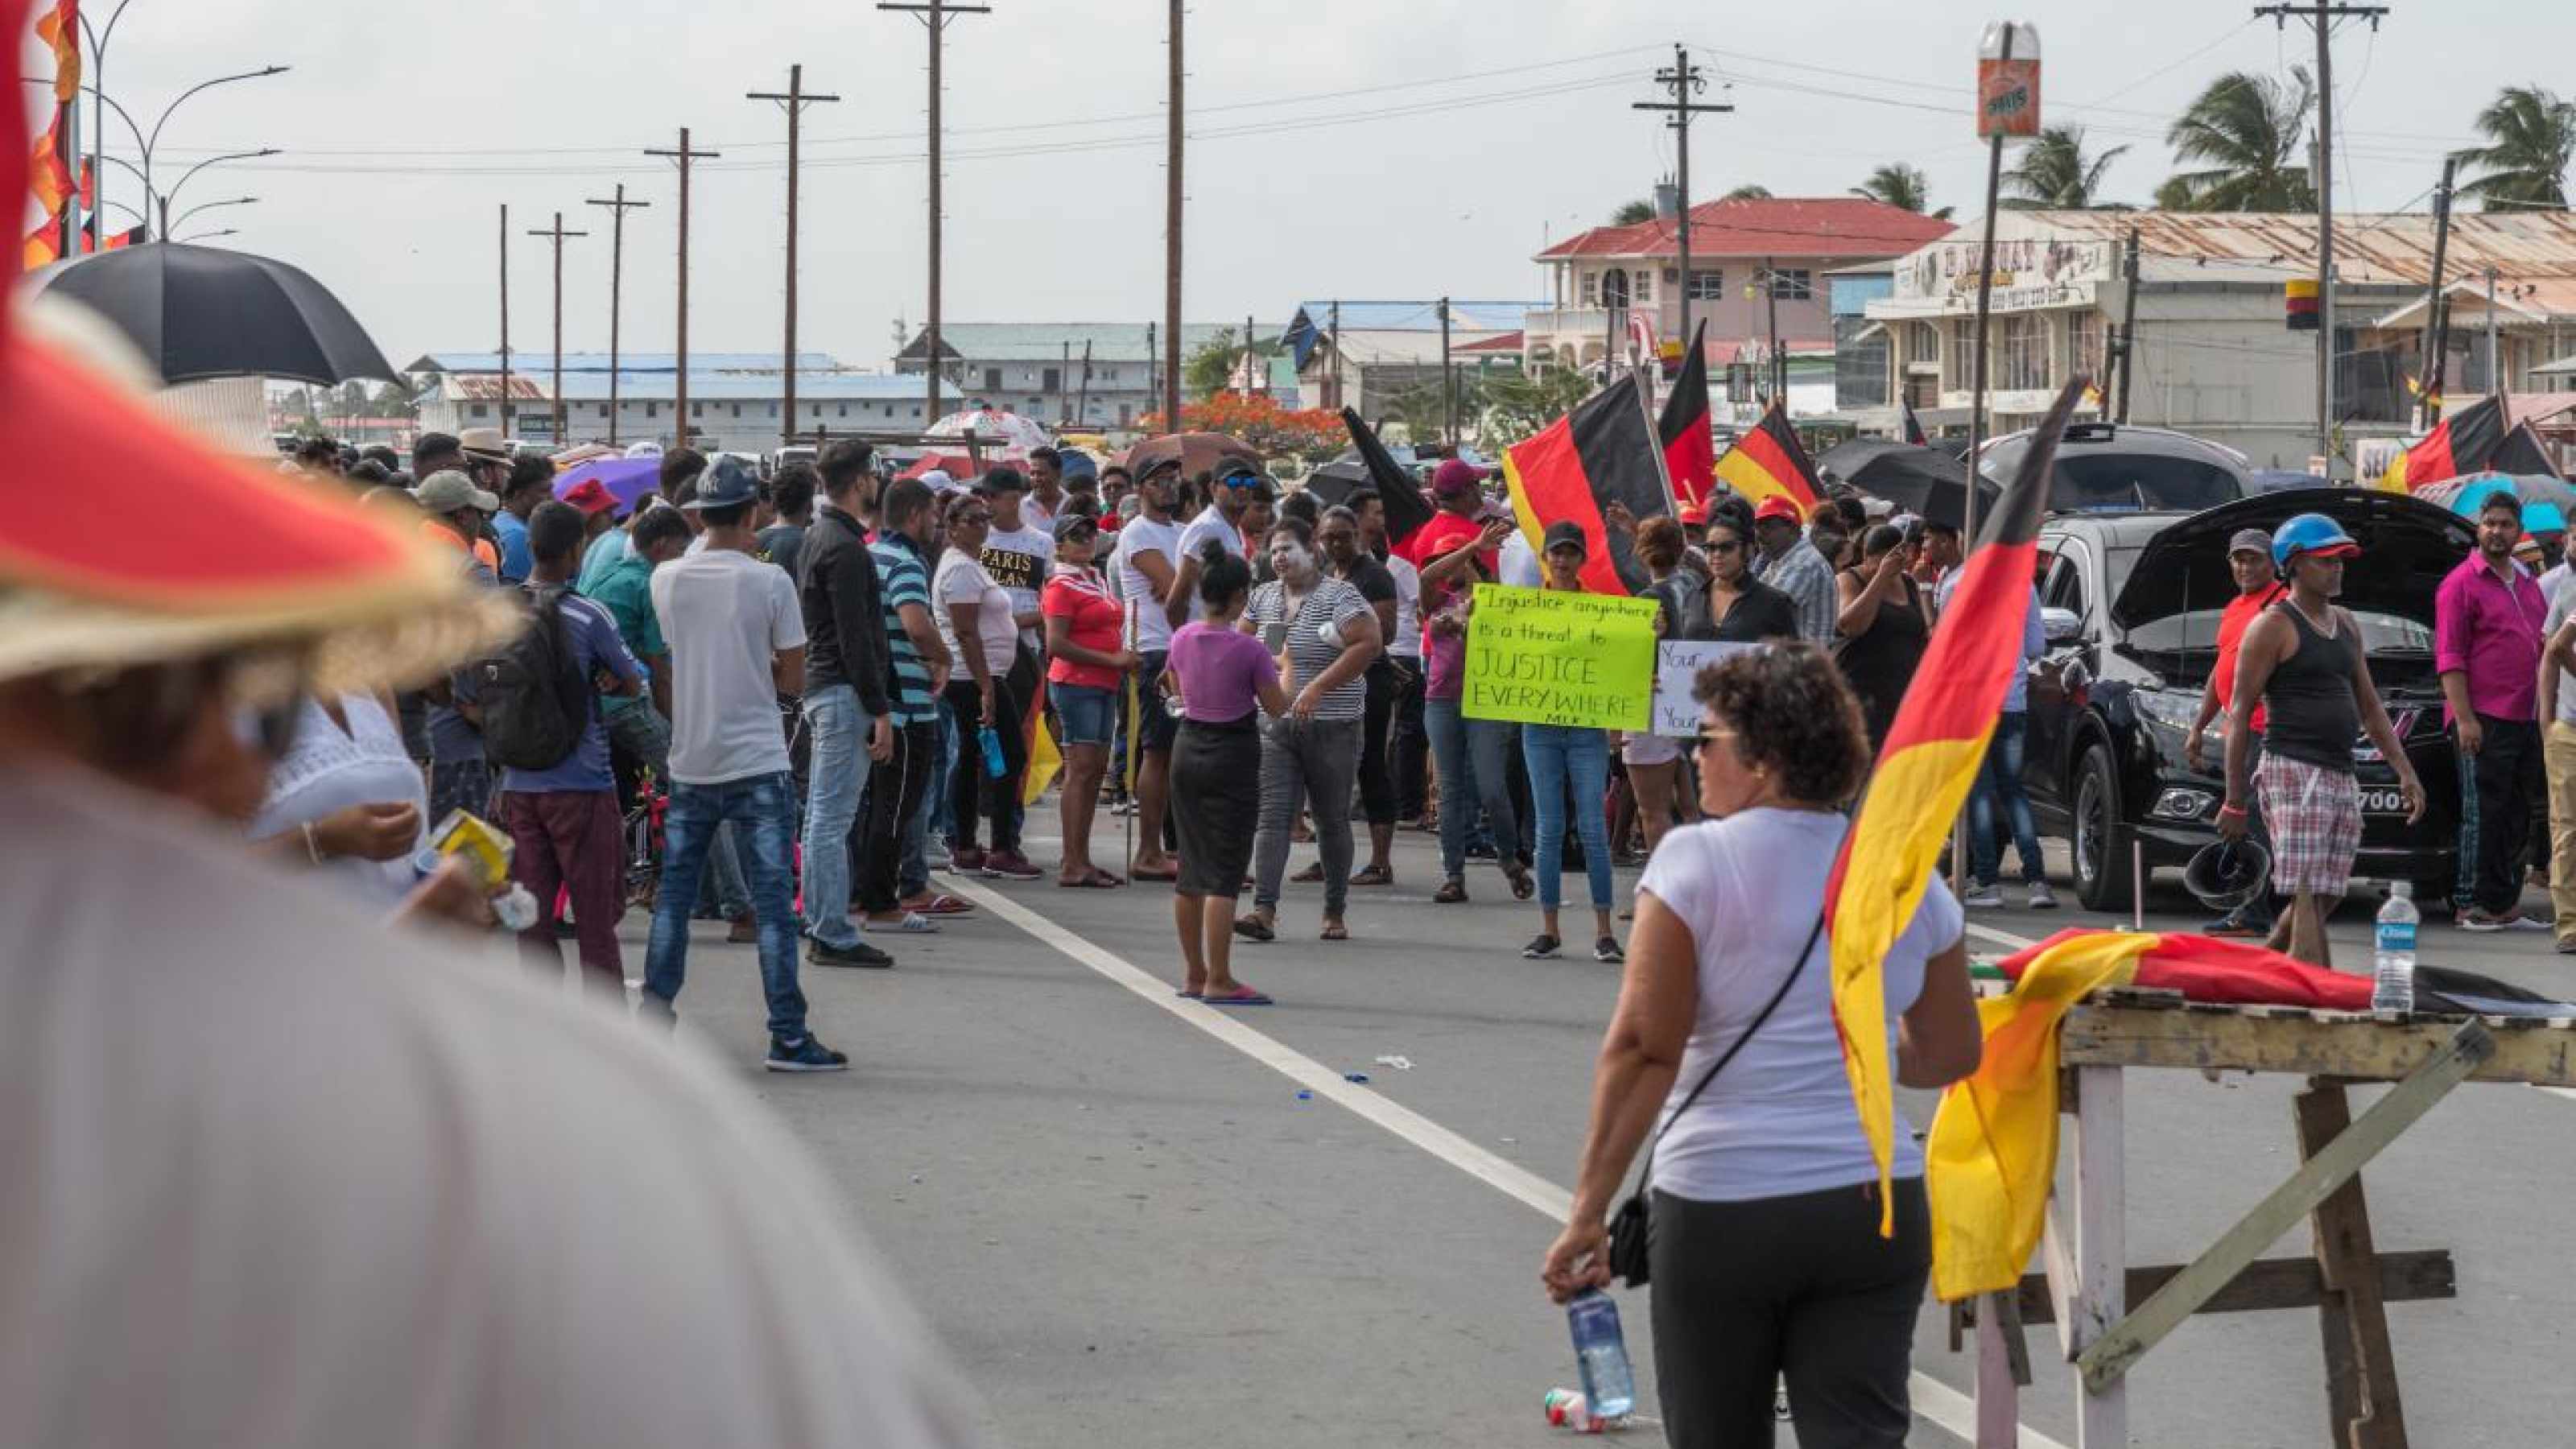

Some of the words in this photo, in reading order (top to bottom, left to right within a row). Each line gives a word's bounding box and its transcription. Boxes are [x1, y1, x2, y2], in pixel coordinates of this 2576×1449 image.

[980, 547, 1031, 572] PARIS
[989, 568, 1027, 587] ILAN
[1573, 599, 1650, 622] anywhere
[1501, 625, 1513, 638] a
[1521, 622, 1571, 642] threat
[1590, 628, 1607, 644] to
[1473, 646, 1599, 684] JUSTICE
[1473, 683, 1637, 718] EVERYWHERE
